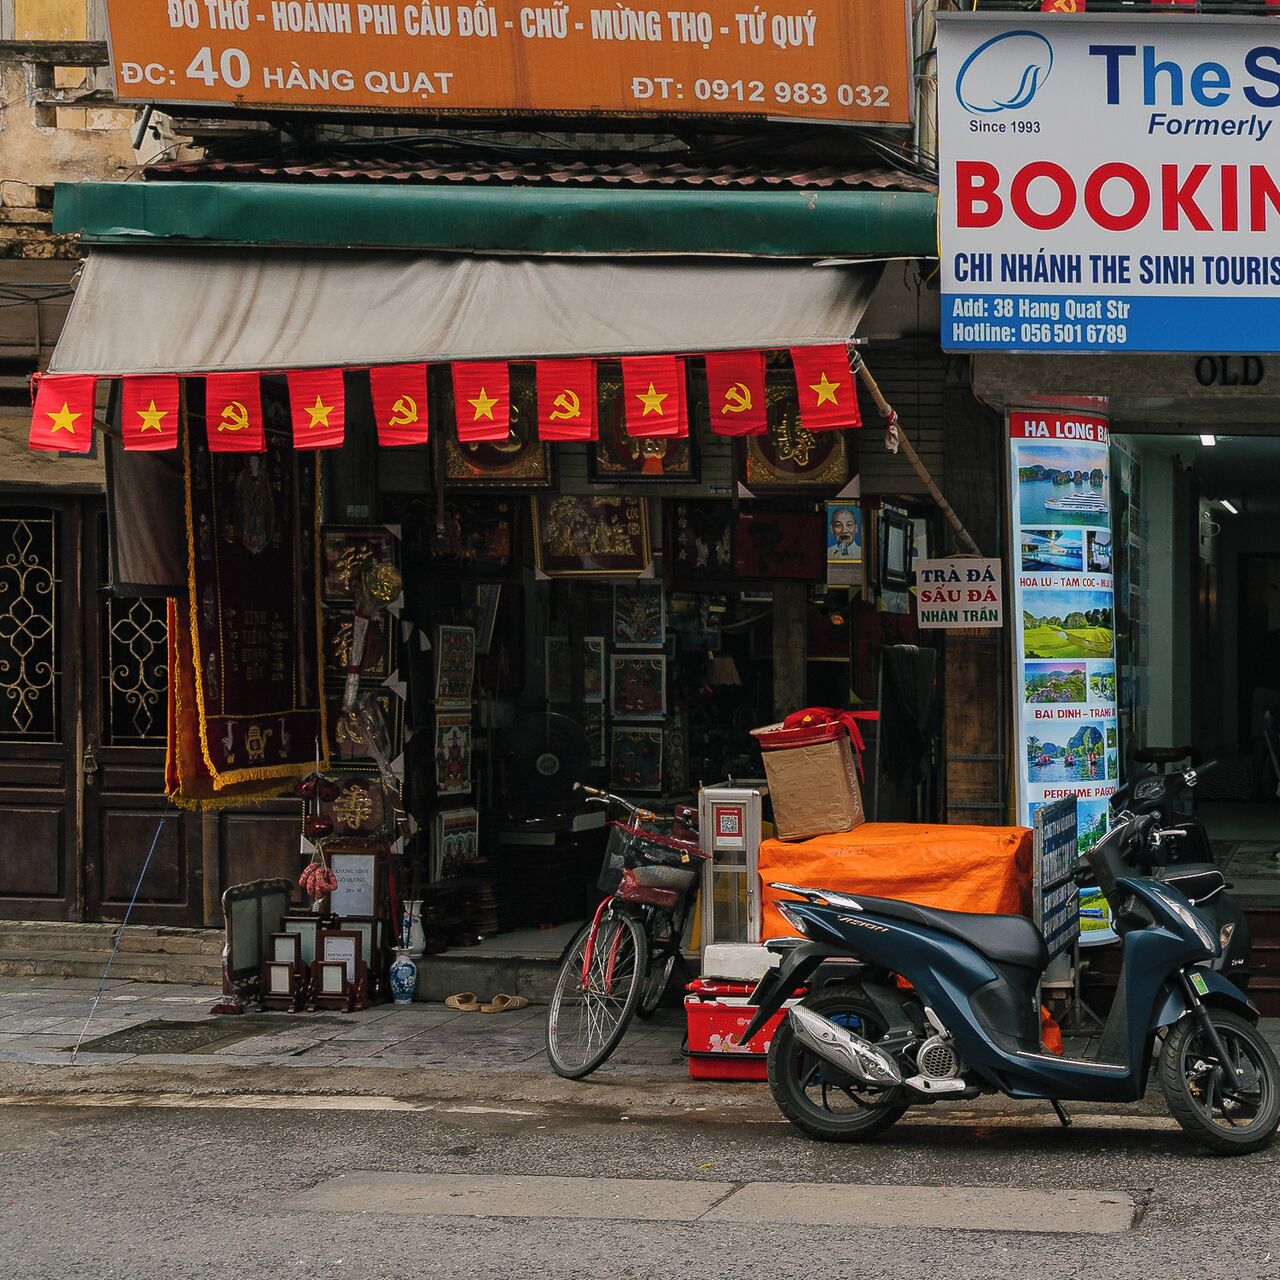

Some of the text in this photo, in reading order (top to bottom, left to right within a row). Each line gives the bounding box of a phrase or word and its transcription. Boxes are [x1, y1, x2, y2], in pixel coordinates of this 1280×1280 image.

[357, 4, 397, 35] PHI
[520, 0, 569, 39] CHỮ
[590, 2, 662, 42] MỪNG
[667, 11, 712, 50] THỌ
[735, 5, 767, 46] TỨ
[771, 9, 817, 50] QUÝ
[121, 46, 453, 99] ĐC: 40 HÀNG QUẠT
[1089, 44, 1232, 108] The
[631, 76, 890, 108] ĐT: 0912 983 032
[969, 120, 1041, 134] Since 1993
[1148, 113, 1272, 142] Formerly
[954, 252, 993, 283] CHI
[1000, 247, 1082, 284] NHÁNH
[1089, 255, 1131, 284] THE
[1139, 255, 1195, 285] SINH
[952, 298, 1130, 321] Add: 38 Hang Quat Str
[952, 323, 1127, 344] Hotline: 056 501 6789
[1195, 356, 1265, 387] OLD
[1025, 421, 1094, 440] HA LONG
[921, 564, 996, 582] TRÀ ĐÁ
[1020, 577, 1096, 587] HOA LU TAM COC
[921, 584, 998, 602] SẤU ĐÁ
[921, 606, 998, 622] NHÂN TRẦN
[1035, 709, 1053, 719] BAI
[1057, 709, 1081, 719] DINH
[1090, 709, 1112, 719] TRANG
